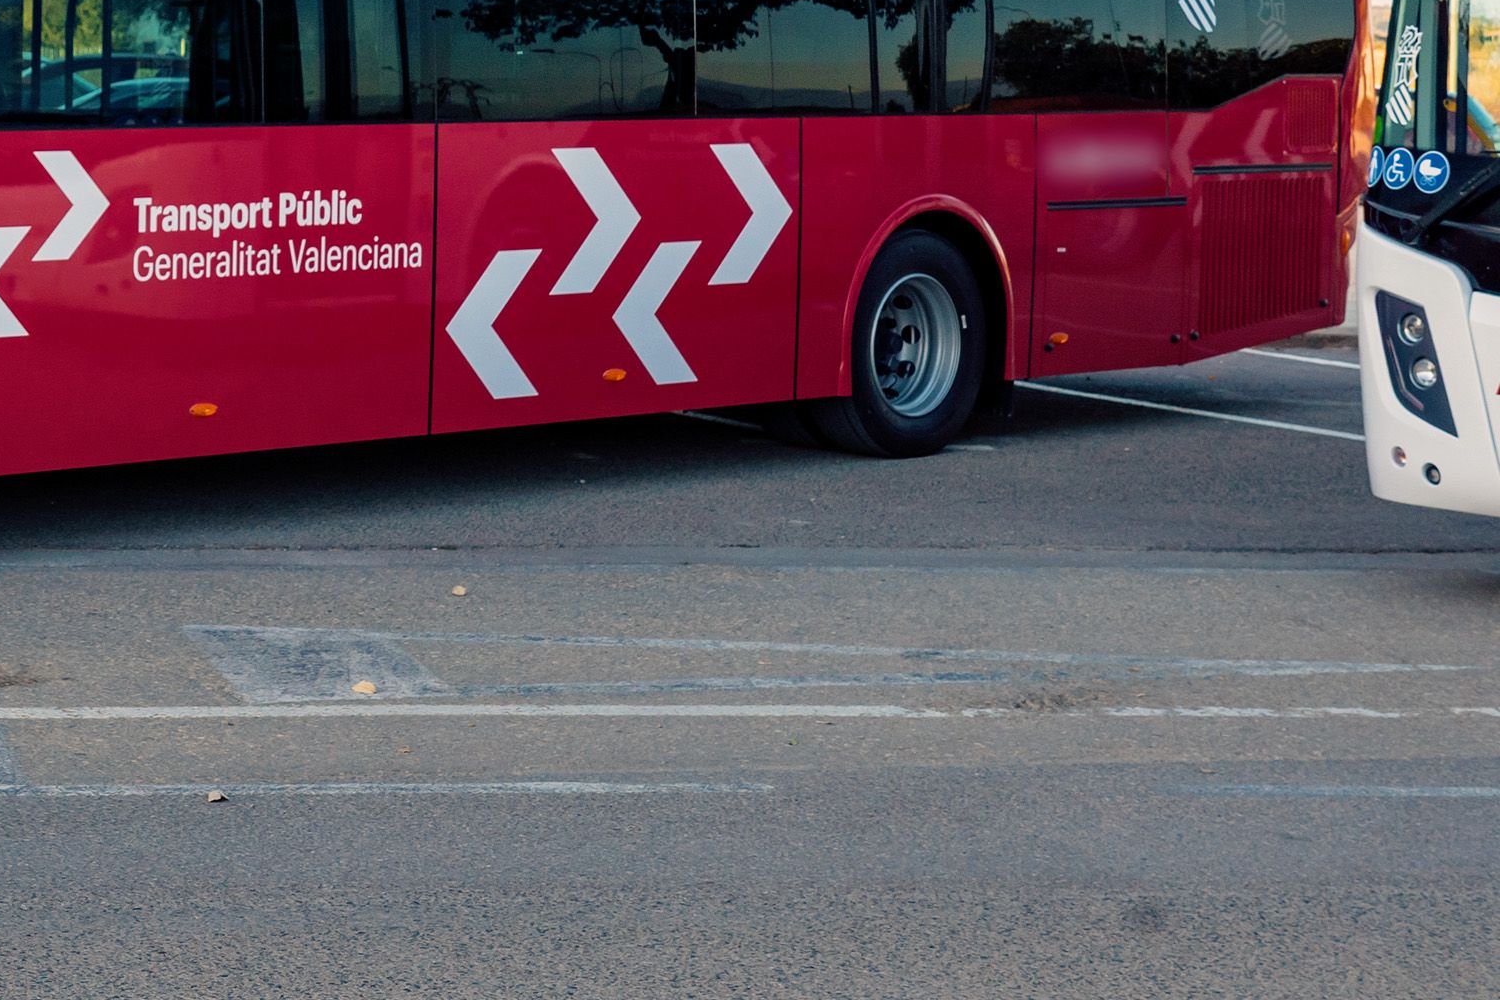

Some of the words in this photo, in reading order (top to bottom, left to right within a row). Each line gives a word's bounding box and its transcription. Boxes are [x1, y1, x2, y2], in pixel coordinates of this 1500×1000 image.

[133, 196, 273, 238] Transport
[278, 189, 363, 227] Públic
[133, 240, 281, 282] Generalitat
[288, 235, 423, 274] Valenciana
